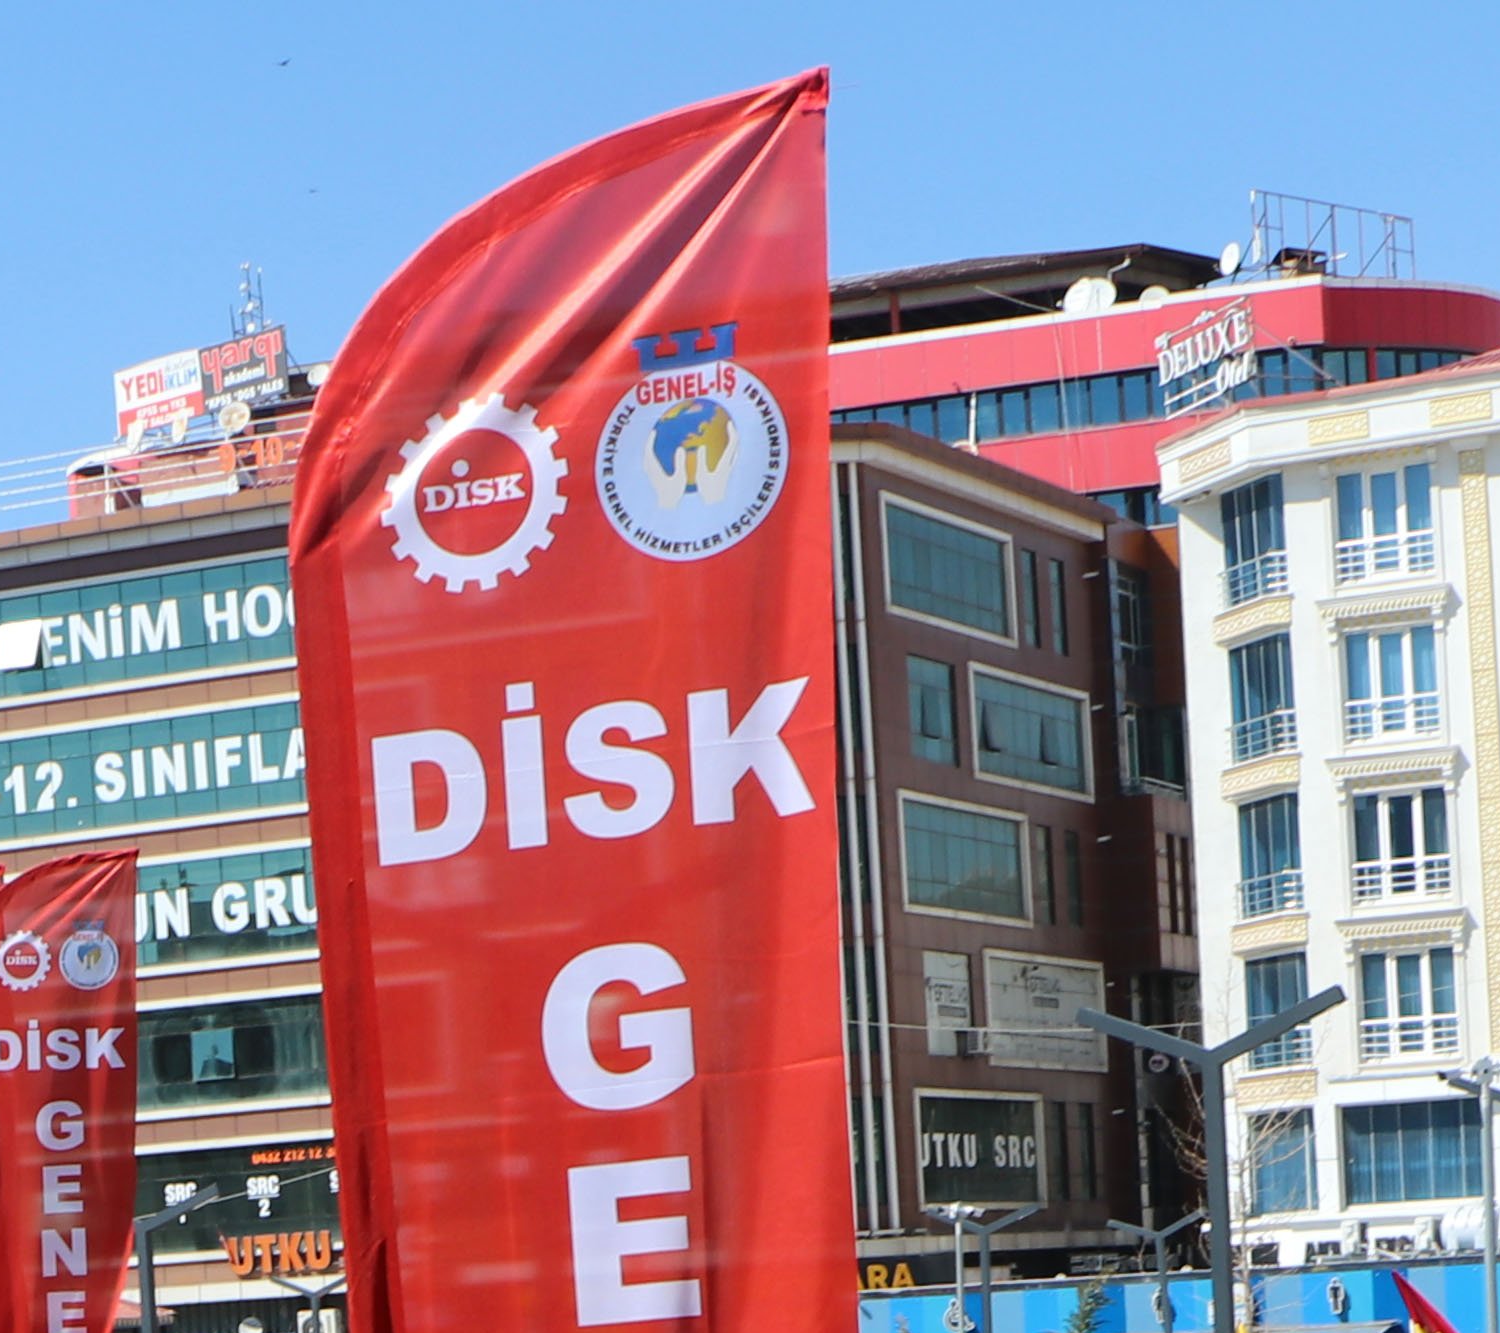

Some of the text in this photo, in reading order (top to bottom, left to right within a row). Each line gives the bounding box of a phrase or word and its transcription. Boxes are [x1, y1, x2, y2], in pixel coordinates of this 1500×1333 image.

[1157, 308, 1249, 387] DELUXE
[636, 362, 737, 405] GENEL-İŞ
[423, 459, 527, 514] DİSK
[602, 383, 781, 554] TÜRKİYE GENEL HİZMETLER İŞÇİLERİ SENDİKASI
[371, 676, 817, 867] DİSK
[994, 1134, 1036, 1168] SRC
[246, 1174, 281, 1197] SRC
[258, 1199, 271, 1218] 2
[226, 1229, 332, 1277] UTKU
